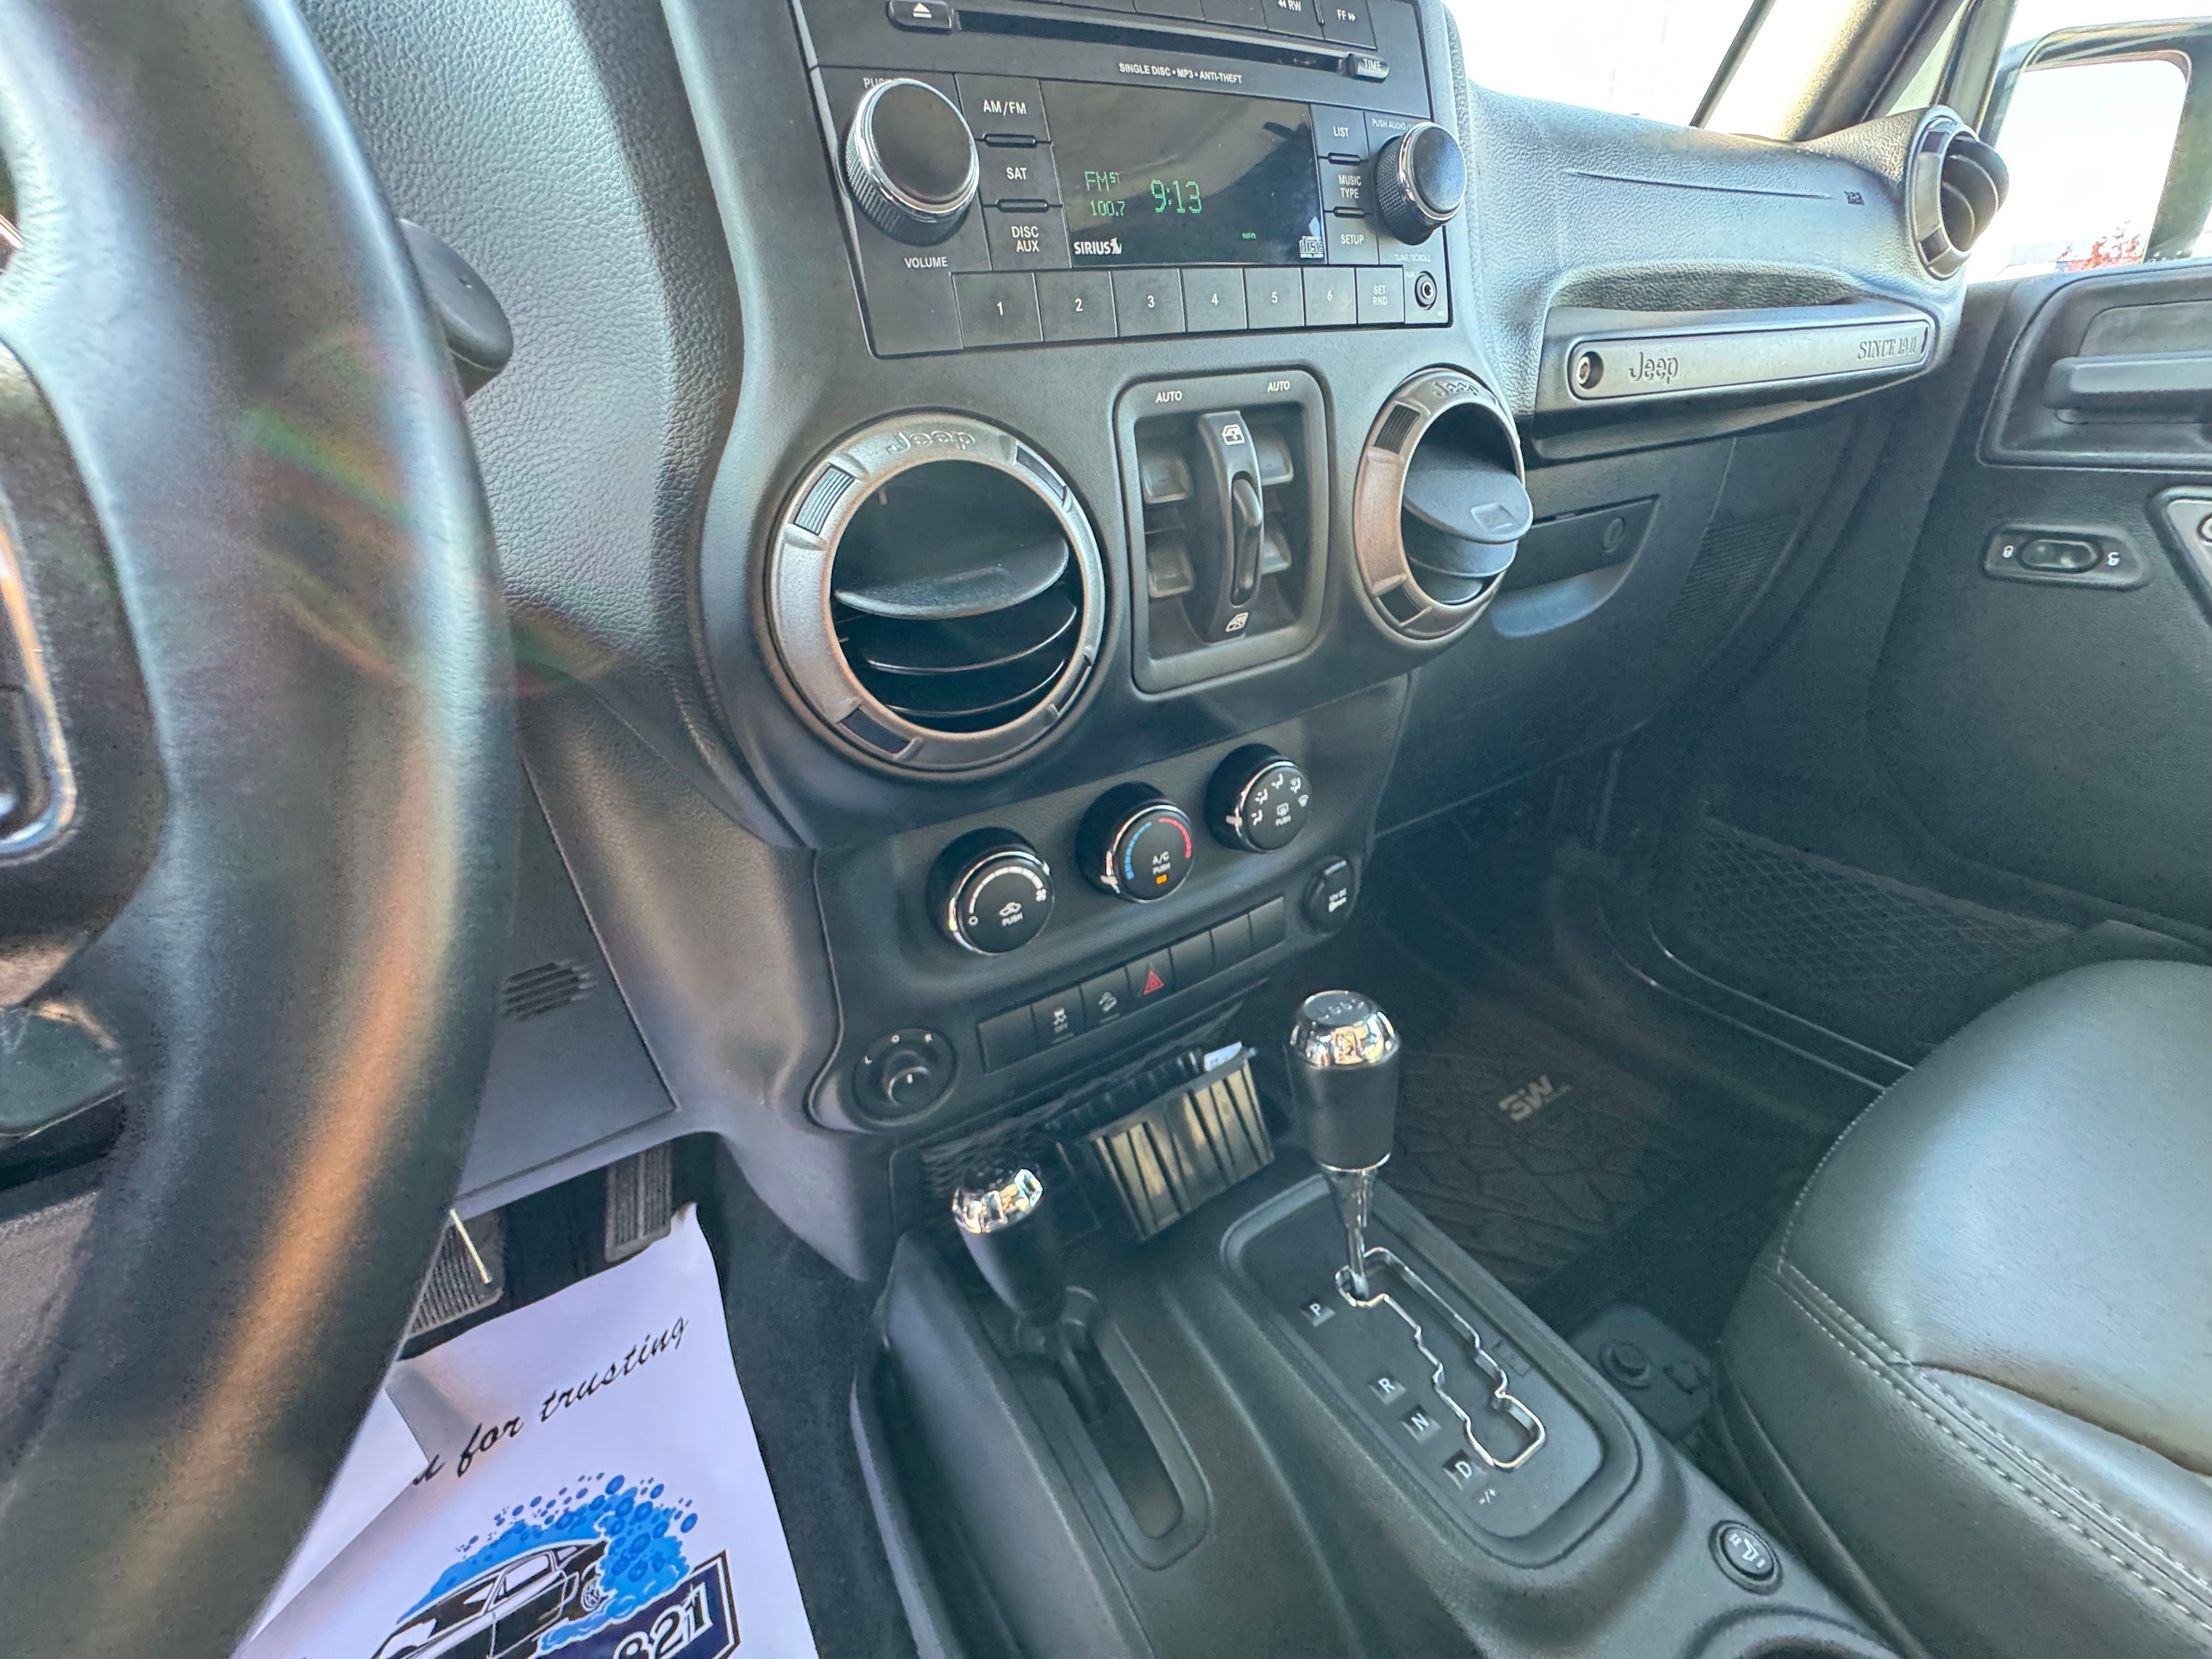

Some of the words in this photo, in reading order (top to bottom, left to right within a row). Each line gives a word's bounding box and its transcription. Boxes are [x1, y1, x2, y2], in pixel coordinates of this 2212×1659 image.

[1288, 0, 1301, 12] RW
[1337, 9, 1346, 21] FF
[1363, 58, 1381, 71] TIME
[1119, 62, 1150, 75] SINGLE
[1151, 65, 1171, 77] DISC
[1177, 68, 1194, 79] MP3
[1199, 71, 1243, 83] ANTI-THEFT
[983, 100, 1027, 116] AM/FM
[1372, 118, 1388, 128] PUSH
[1333, 126, 1349, 138] LIST
[1006, 167, 1027, 180] SAT
[1338, 174, 1361, 187] MUSIC
[1150, 179, 1203, 214] 9:13
[1340, 188, 1359, 199] TYPE
[1090, 200, 1125, 217] 100.7
[1011, 225, 1039, 238] DISC
[1016, 240, 1040, 252] AUX
[1340, 234, 1364, 245] SETUP
[1074, 241, 1111, 256] SIRIUS
[904, 256, 949, 269] VOLUME
[1327, 290, 1333, 302] 6
[1373, 285, 1387, 295] SET
[1147, 295, 1155, 308] 3
[1211, 294, 1219, 306] 4
[1271, 291, 1278, 303] 5
[1373, 296, 1388, 306] RND
[996, 302, 1004, 315] 1
[1074, 298, 1084, 312] 2
[1857, 338, 1896, 360] SINCE
[1628, 351, 1679, 385] Jeep
[1267, 380, 1291, 392] AUTO
[1155, 390, 1183, 403] AUTO
[1152, 851, 1170, 865] A/C
[1310, 1304, 1322, 1317] P
[1378, 1378, 1396, 1393] R
[457, 1416, 524, 1478] for
[539, 1316, 689, 1423] trusting
[1410, 1412, 1429, 1431] N
[1455, 1461, 1472, 1479] D
